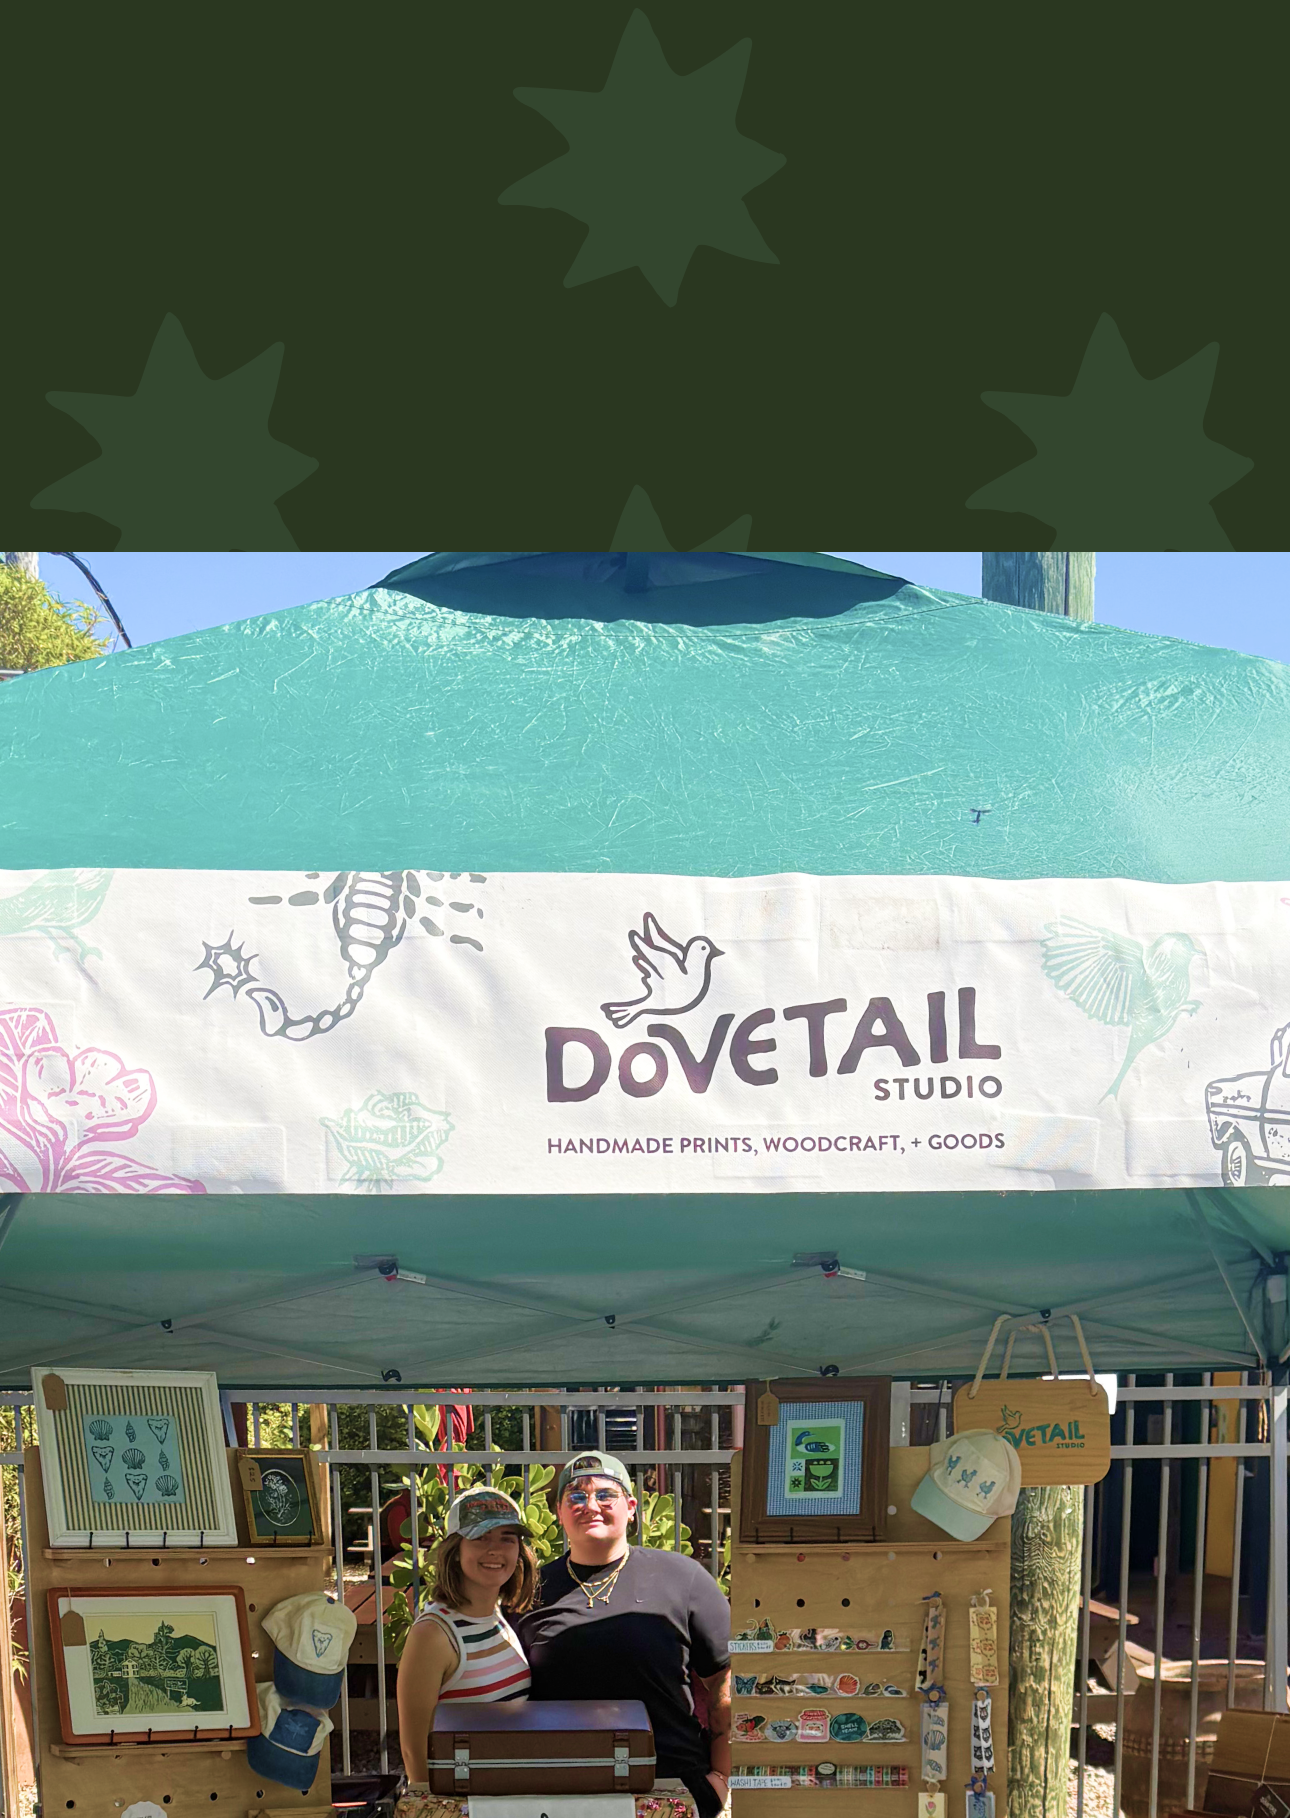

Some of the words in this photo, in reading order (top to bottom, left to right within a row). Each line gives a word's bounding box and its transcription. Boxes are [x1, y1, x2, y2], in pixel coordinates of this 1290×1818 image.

[545, 986, 1002, 1103] DOVETAIL
[873, 1075, 1003, 1101] STUDIO
[547, 1136, 674, 1155] HANDMADE
[679, 1135, 759, 1157] PRINTS,
[763, 1133, 905, 1155] WOODCRAFT,
[910, 1137, 923, 1150] +
[927, 1131, 1006, 1151] GOODS
